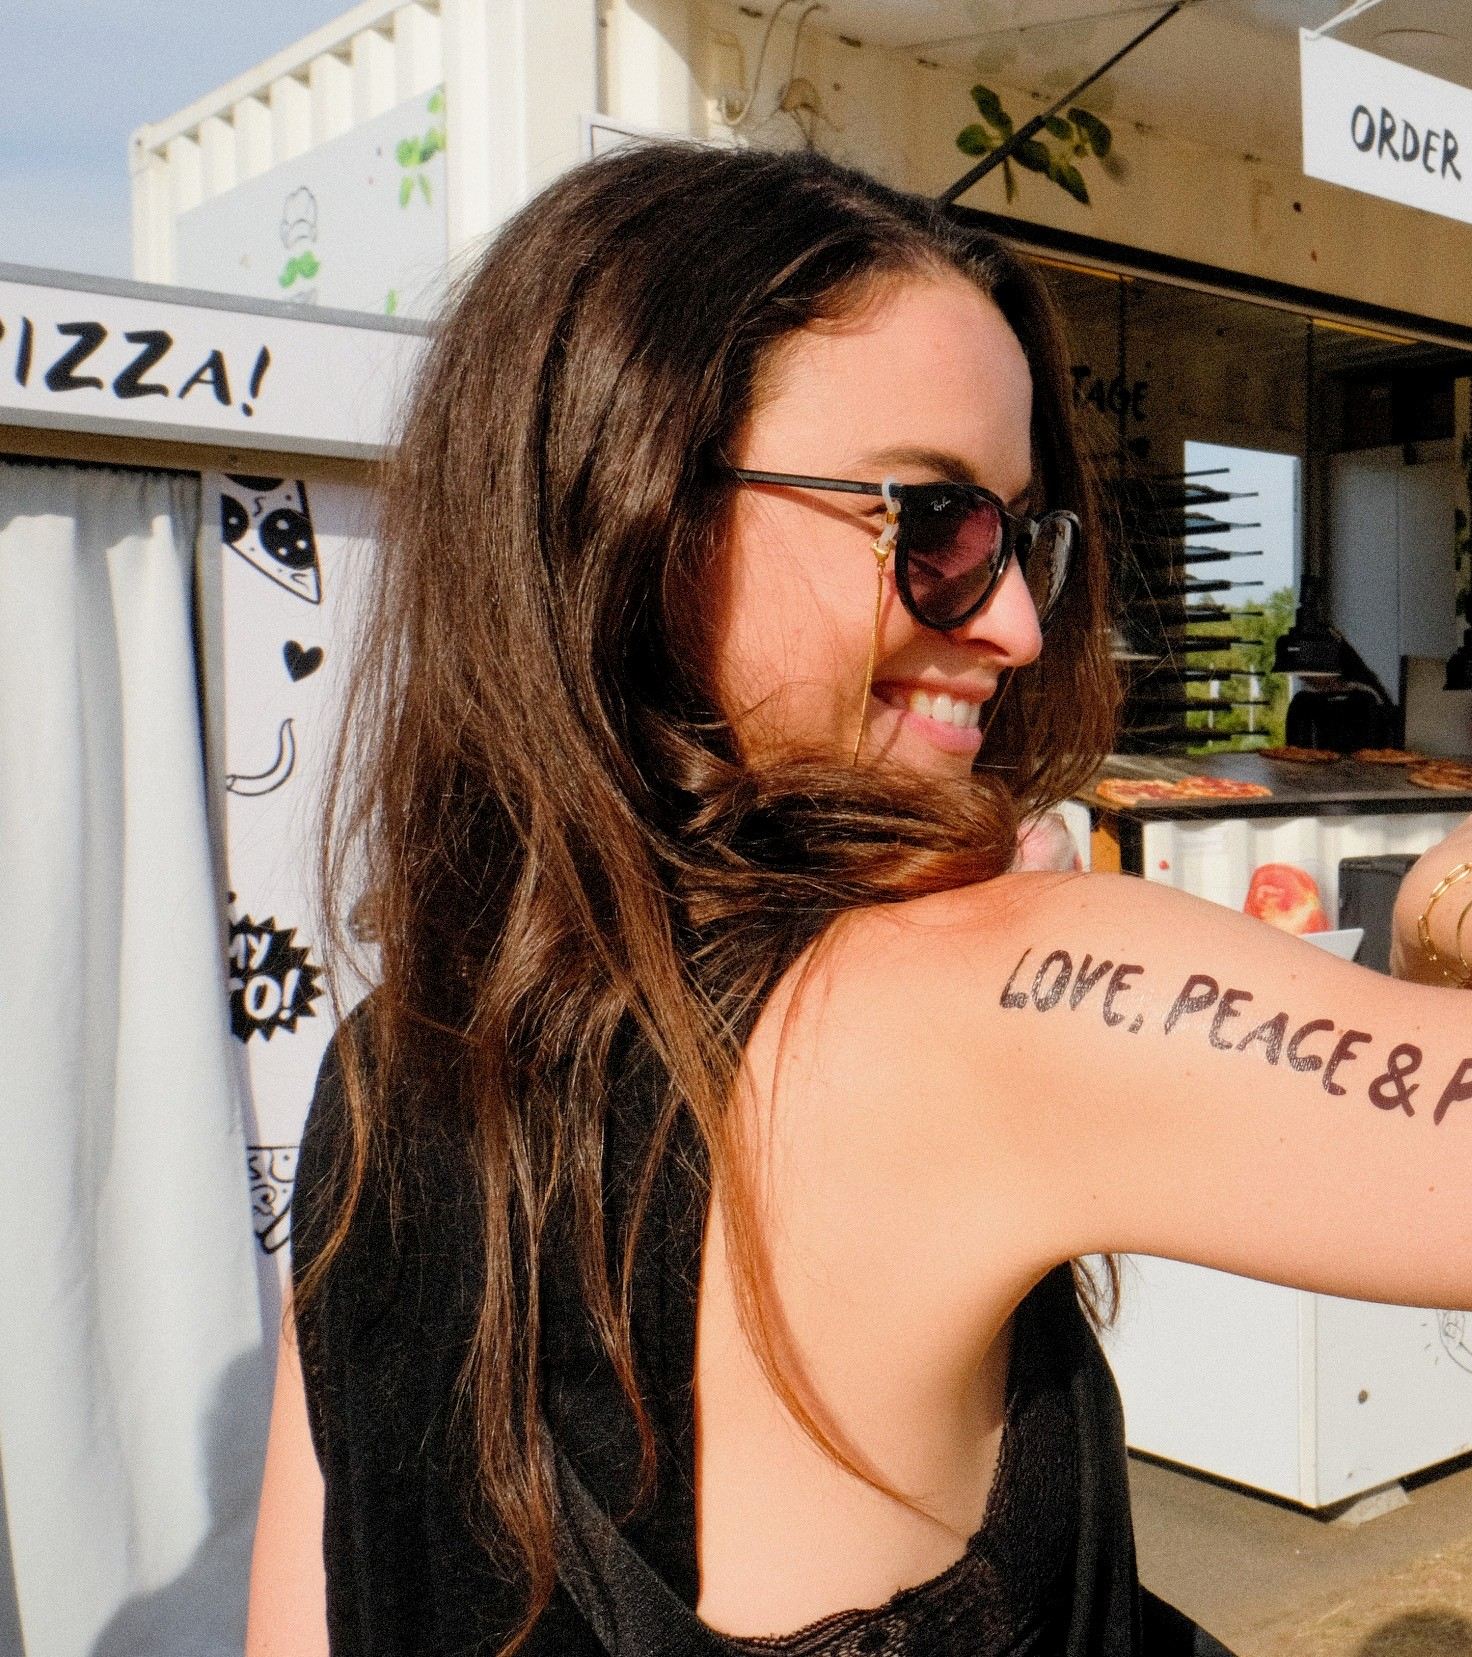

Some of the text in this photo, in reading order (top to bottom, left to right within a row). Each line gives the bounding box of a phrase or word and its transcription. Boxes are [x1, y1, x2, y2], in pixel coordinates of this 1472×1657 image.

[1350, 104, 1462, 184] ORDER
[0, 314, 271, 417] IZZA!
[229, 967, 300, 1020] O!
[1000, 946, 1145, 1034] LOVE,
[1163, 973, 1373, 1097] PEACE
[1367, 1041, 1425, 1119] &
